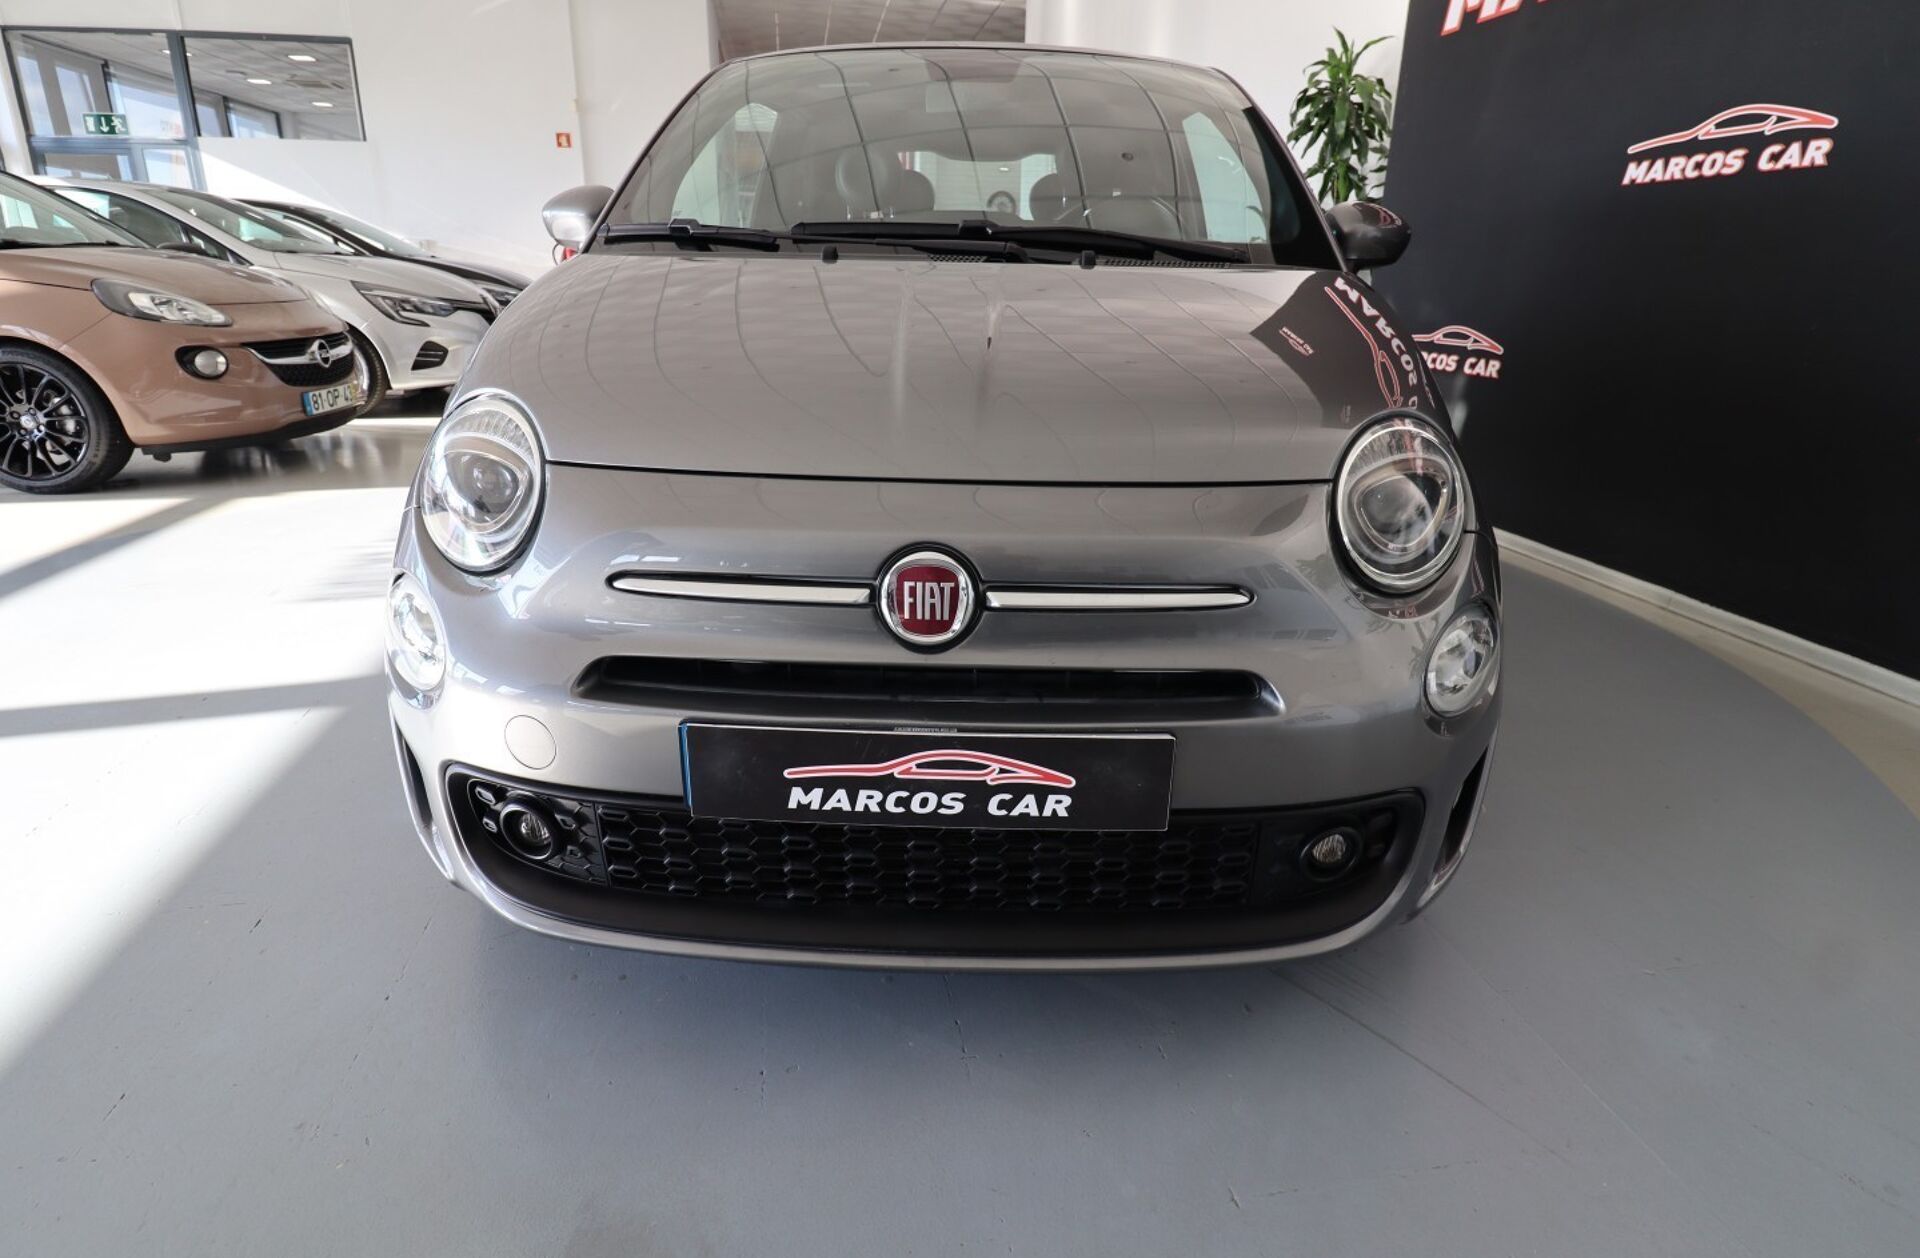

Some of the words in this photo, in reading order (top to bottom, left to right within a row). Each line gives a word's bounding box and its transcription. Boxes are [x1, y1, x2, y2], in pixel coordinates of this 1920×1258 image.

[1621, 148, 1749, 185] MARCOS
[1757, 138, 1834, 171] CAR
[1420, 351, 1459, 372] COS
[1463, 357, 1501, 379] CAR
[903, 581, 955, 621] FIAT
[787, 786, 966, 815] MARCOS
[987, 793, 1073, 817] CAR
